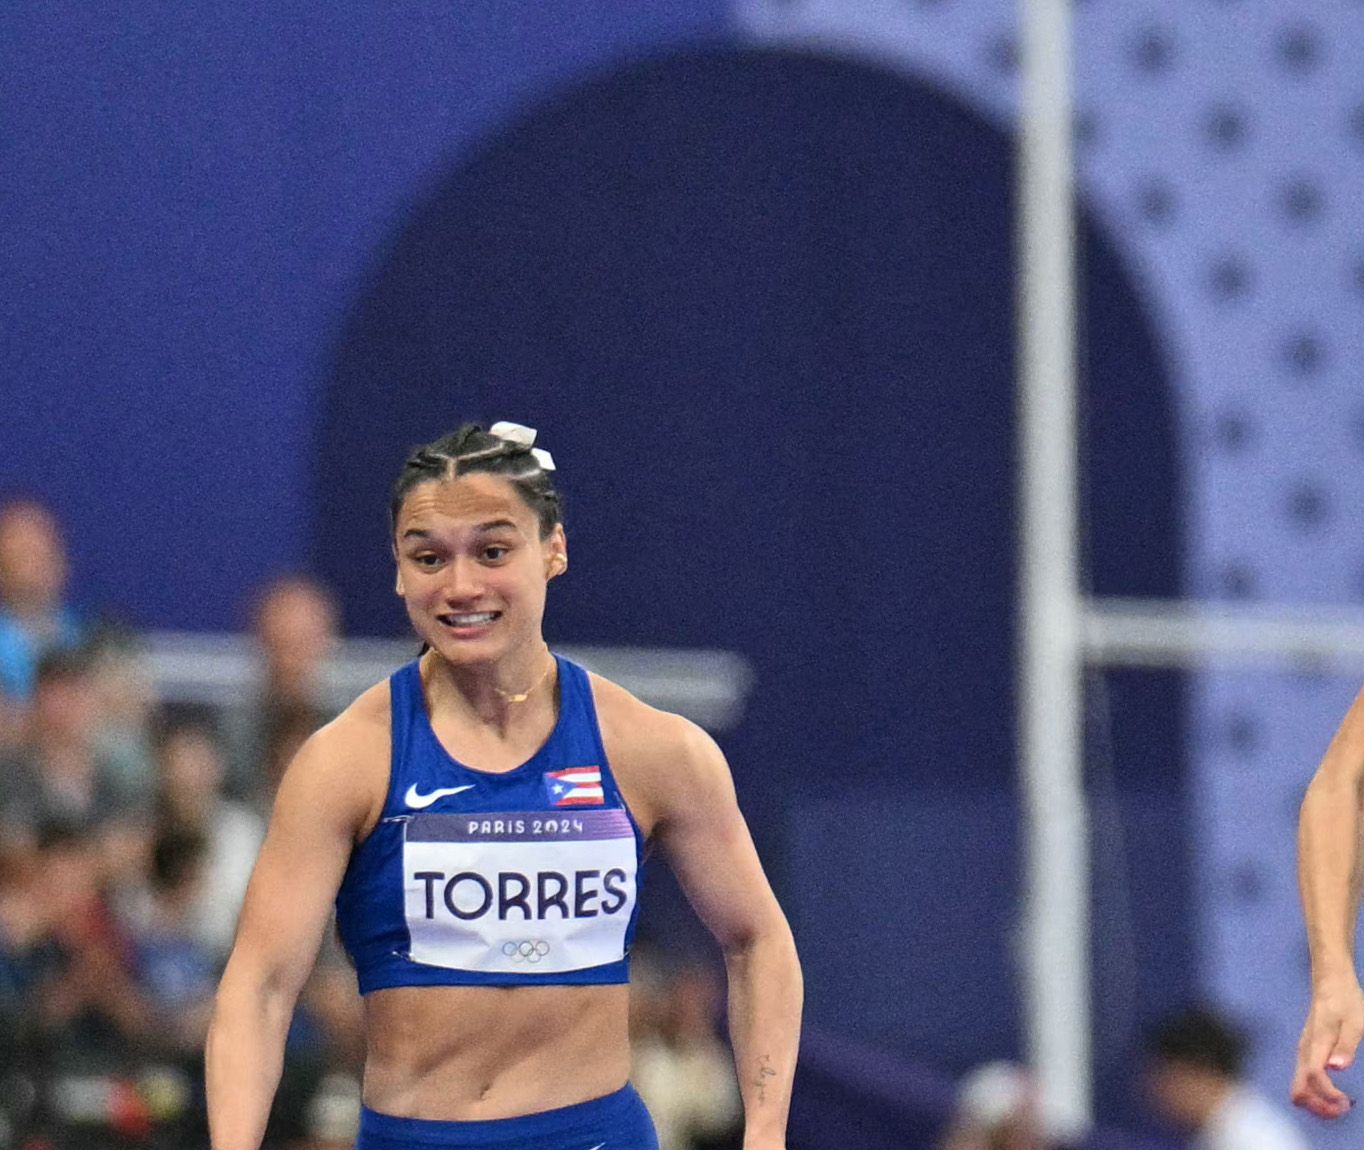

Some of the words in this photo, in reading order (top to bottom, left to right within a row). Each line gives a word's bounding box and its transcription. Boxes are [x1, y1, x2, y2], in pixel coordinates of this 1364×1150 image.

[467, 820, 525, 835] PARIS
[532, 819, 584, 835] 2024
[413, 867, 628, 921] TORRES
